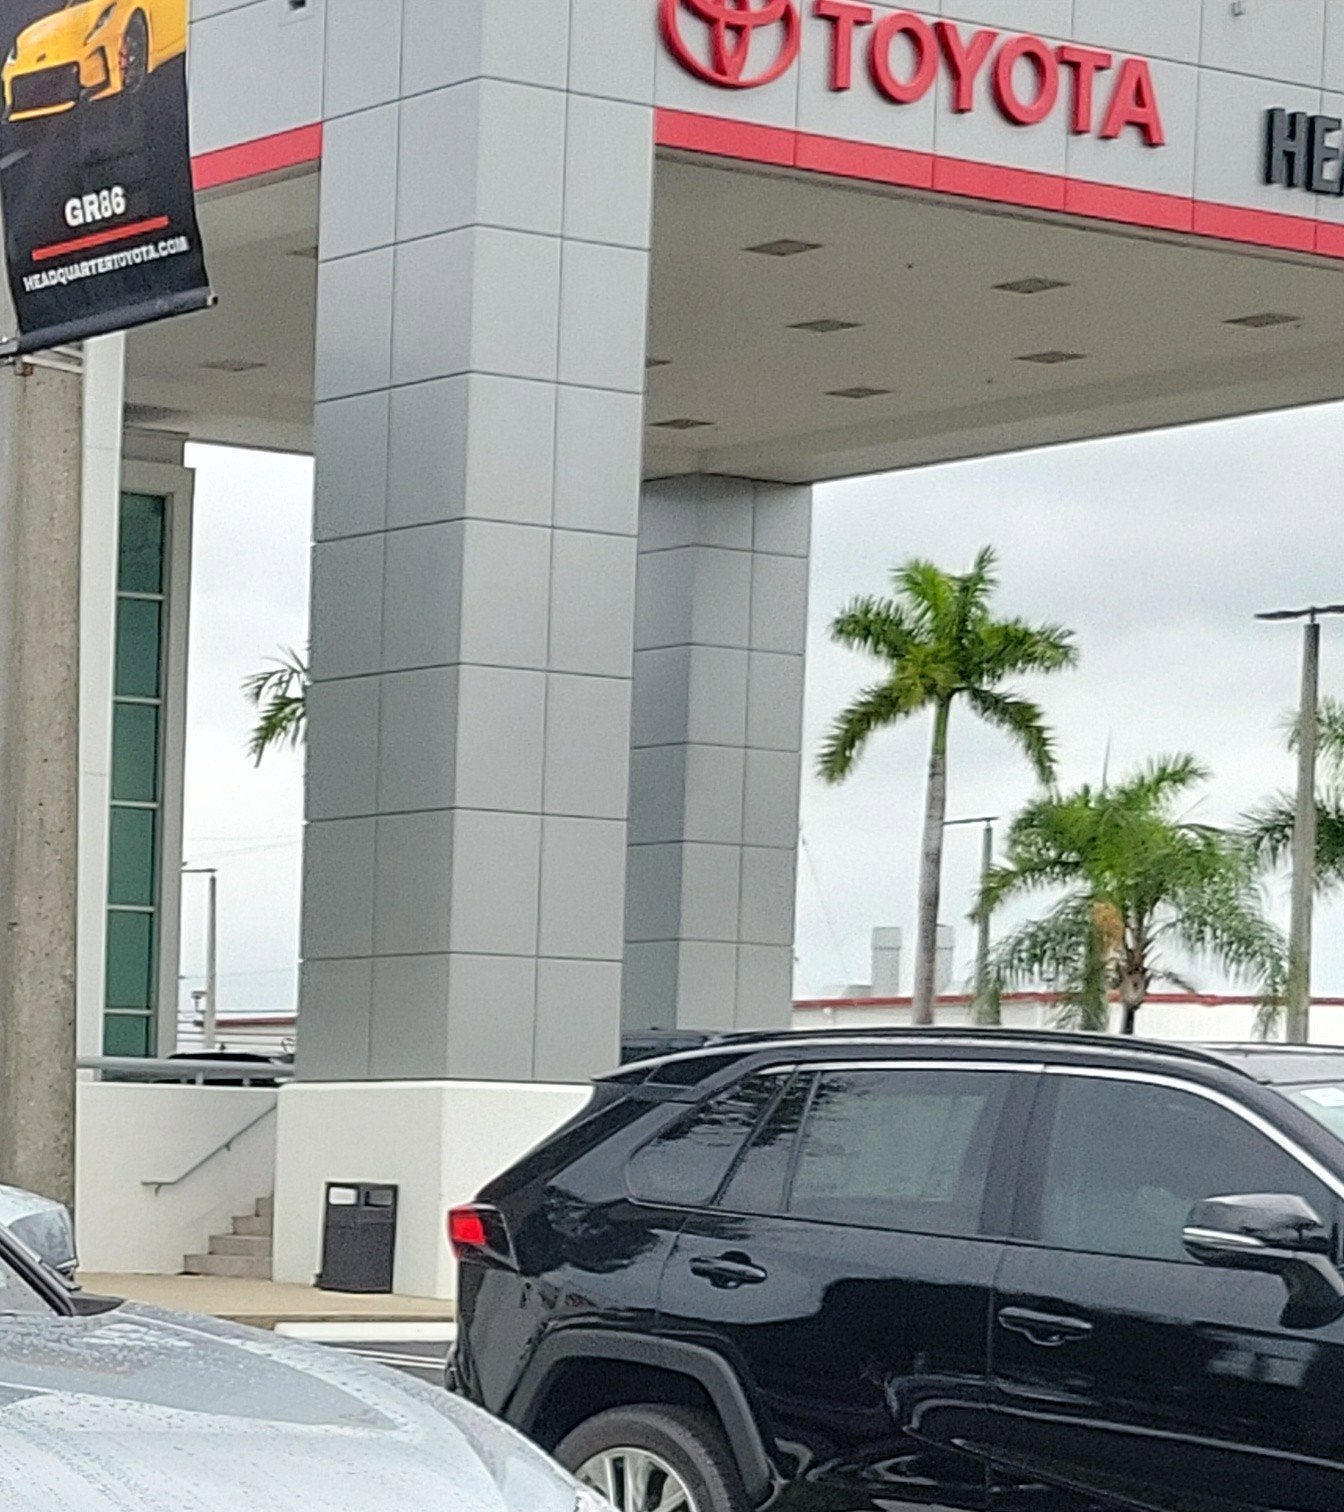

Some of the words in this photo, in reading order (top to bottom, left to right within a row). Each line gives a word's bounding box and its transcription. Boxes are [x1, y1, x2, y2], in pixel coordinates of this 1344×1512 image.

[814, 1, 1165, 147] TOYOTA
[64, 185, 127, 228] GR86
[22, 235, 190, 292] HEADQUARTERTOYOTA.COM
